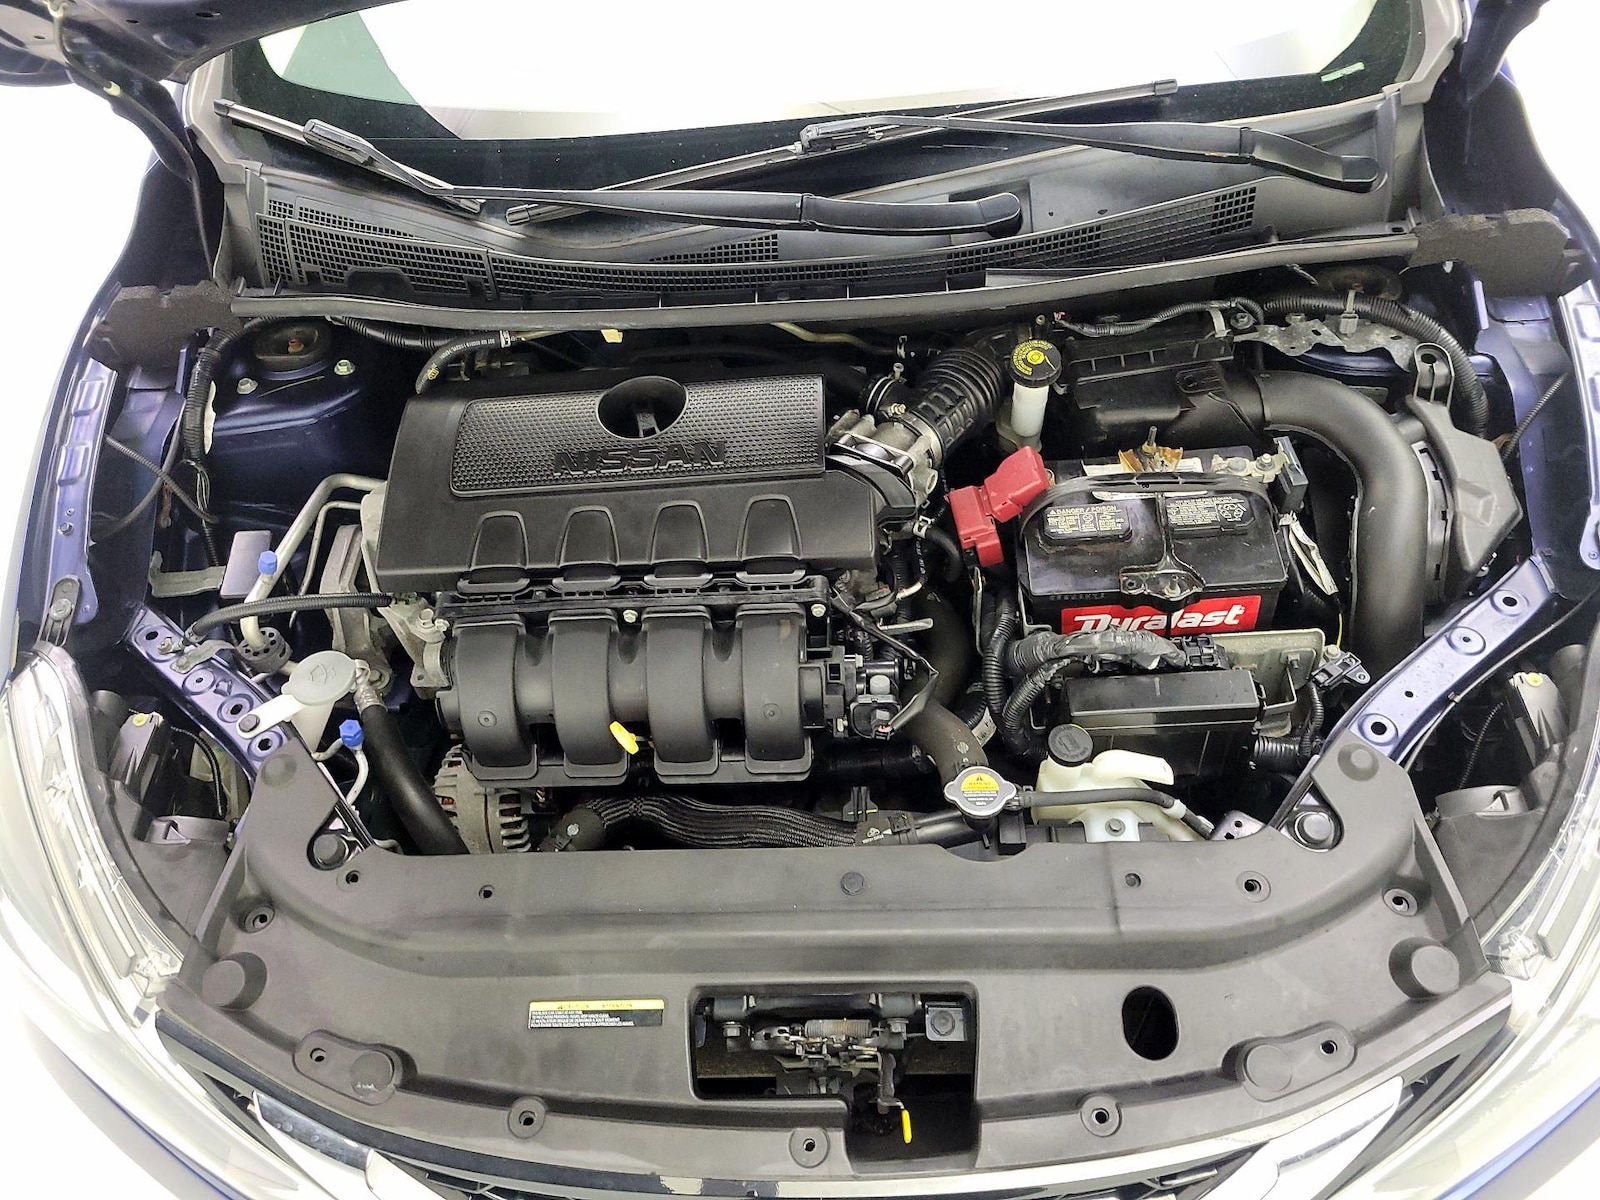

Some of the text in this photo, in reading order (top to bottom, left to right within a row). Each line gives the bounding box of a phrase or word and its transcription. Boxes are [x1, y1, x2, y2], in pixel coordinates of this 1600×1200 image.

[553, 440, 726, 475] NISSAN
[1056, 507, 1085, 515] DANGER
[1091, 505, 1117, 513] POISON
[1073, 604, 1246, 632] Duralast
